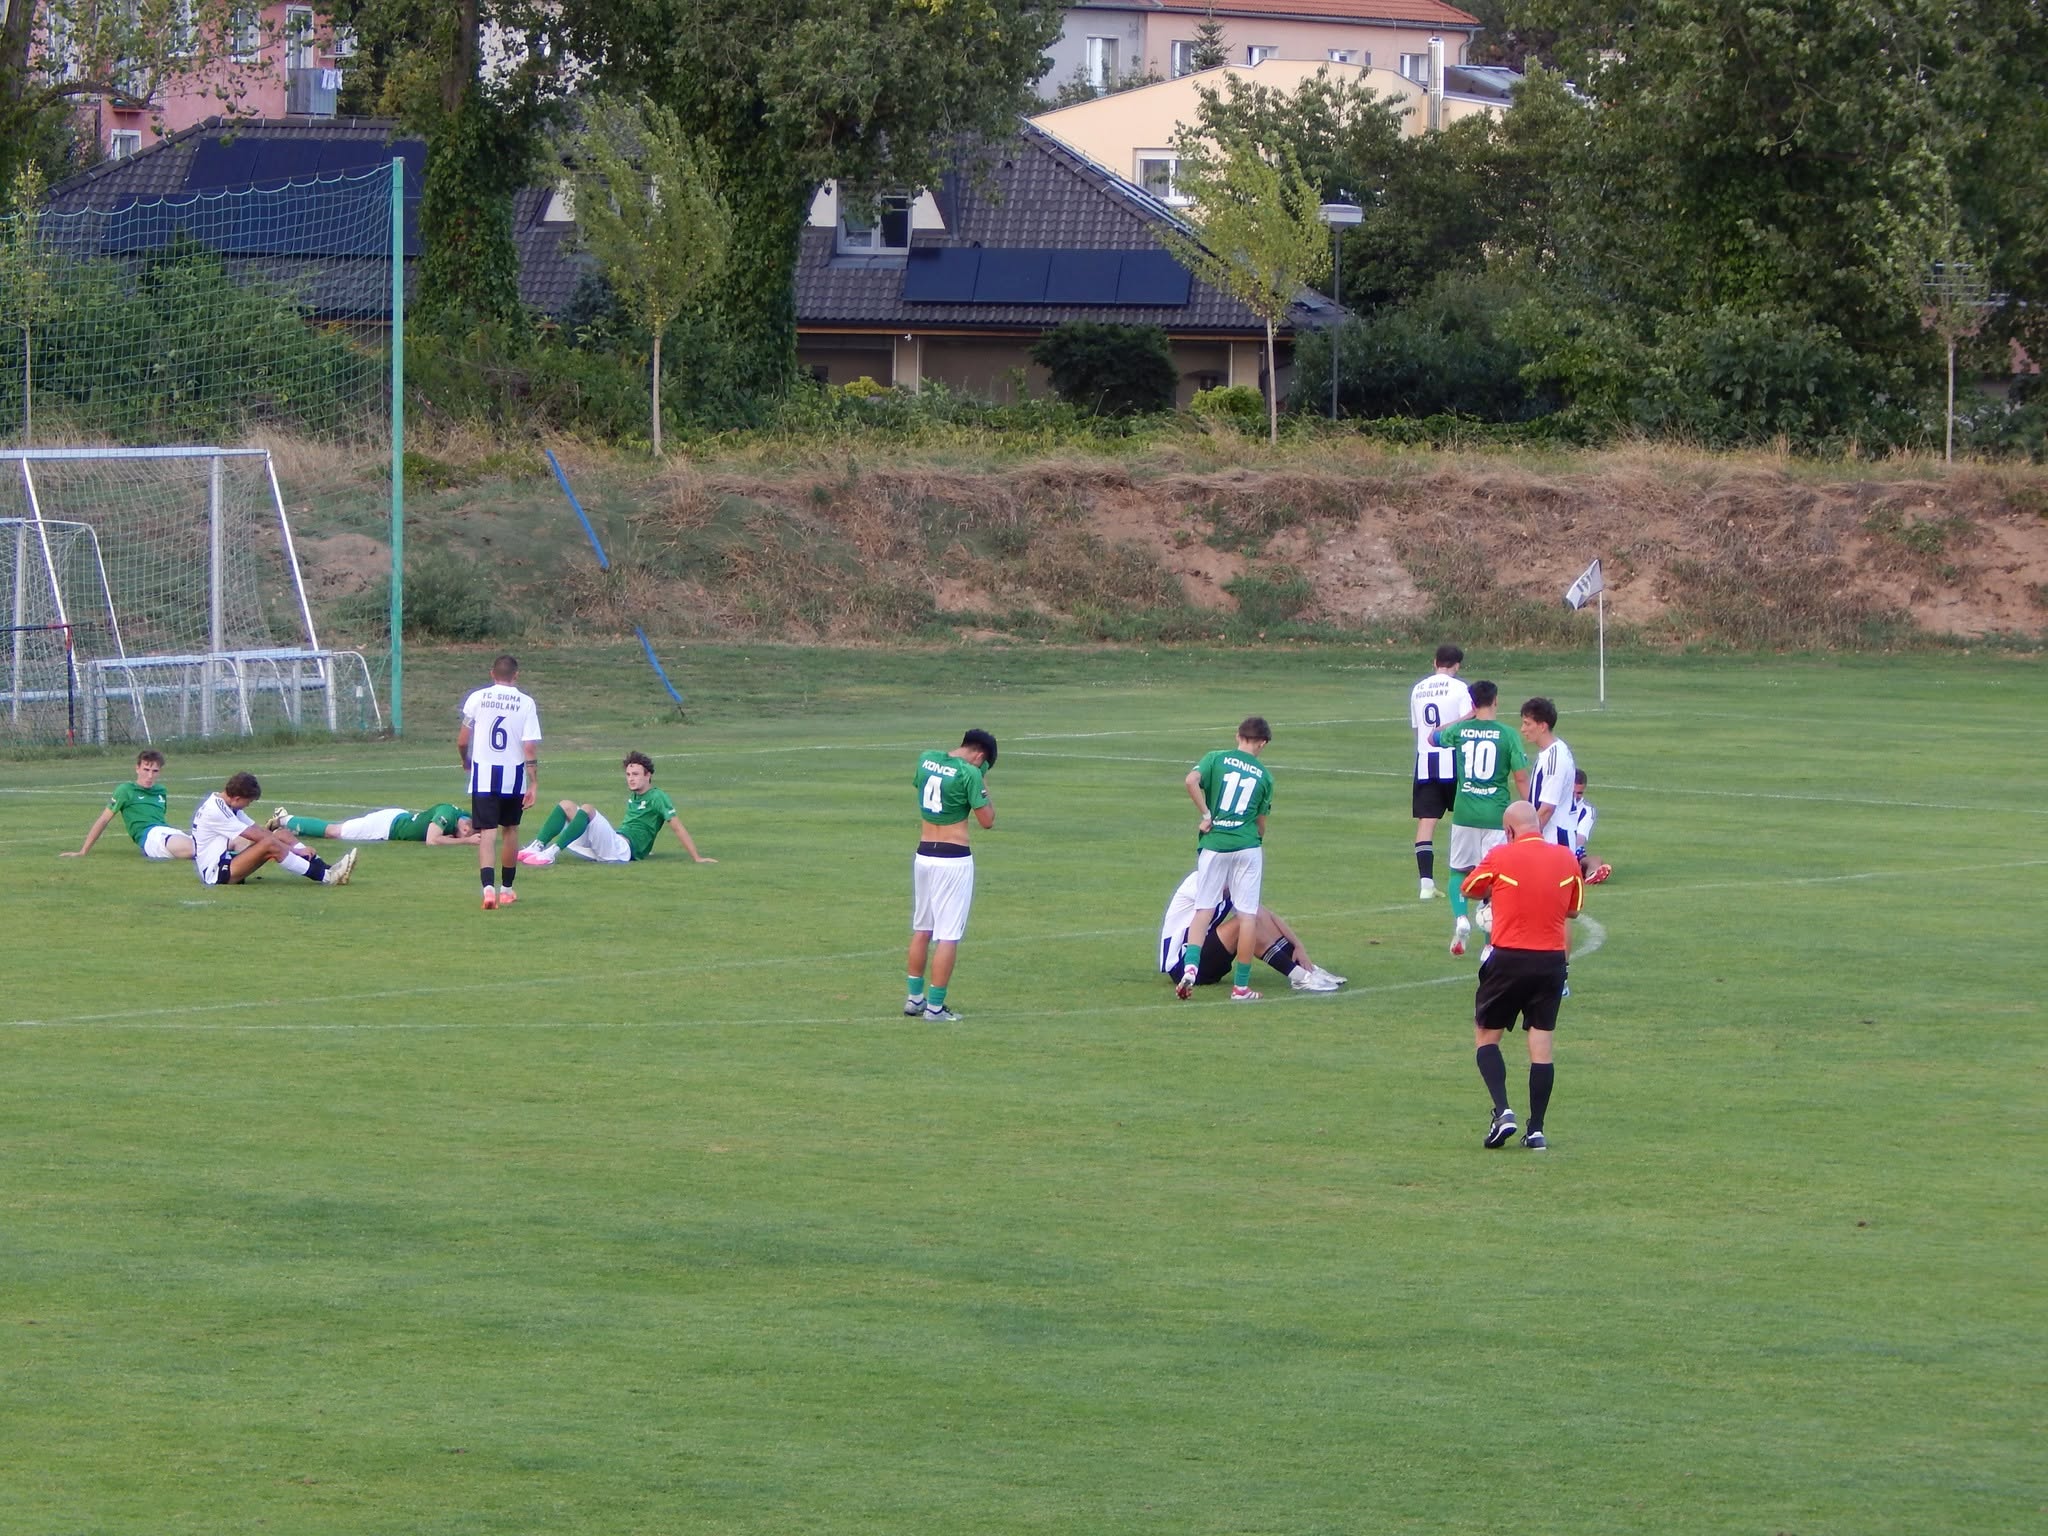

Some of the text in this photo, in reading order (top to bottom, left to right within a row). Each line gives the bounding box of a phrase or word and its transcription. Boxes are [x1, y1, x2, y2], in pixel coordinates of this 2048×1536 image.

[481, 701, 521, 712] HODOLANY
[497, 693, 521, 703] SIGMA
[1423, 703, 1441, 728] 9
[489, 716, 508, 752] 6
[1460, 729, 1501, 739] KONICE
[922, 759, 958, 777] KONCE
[1223, 757, 1263, 778] KONICE
[1461, 740, 1497, 780] 10
[923, 775, 943, 813] 4
[1220, 771, 1257, 815] 11
